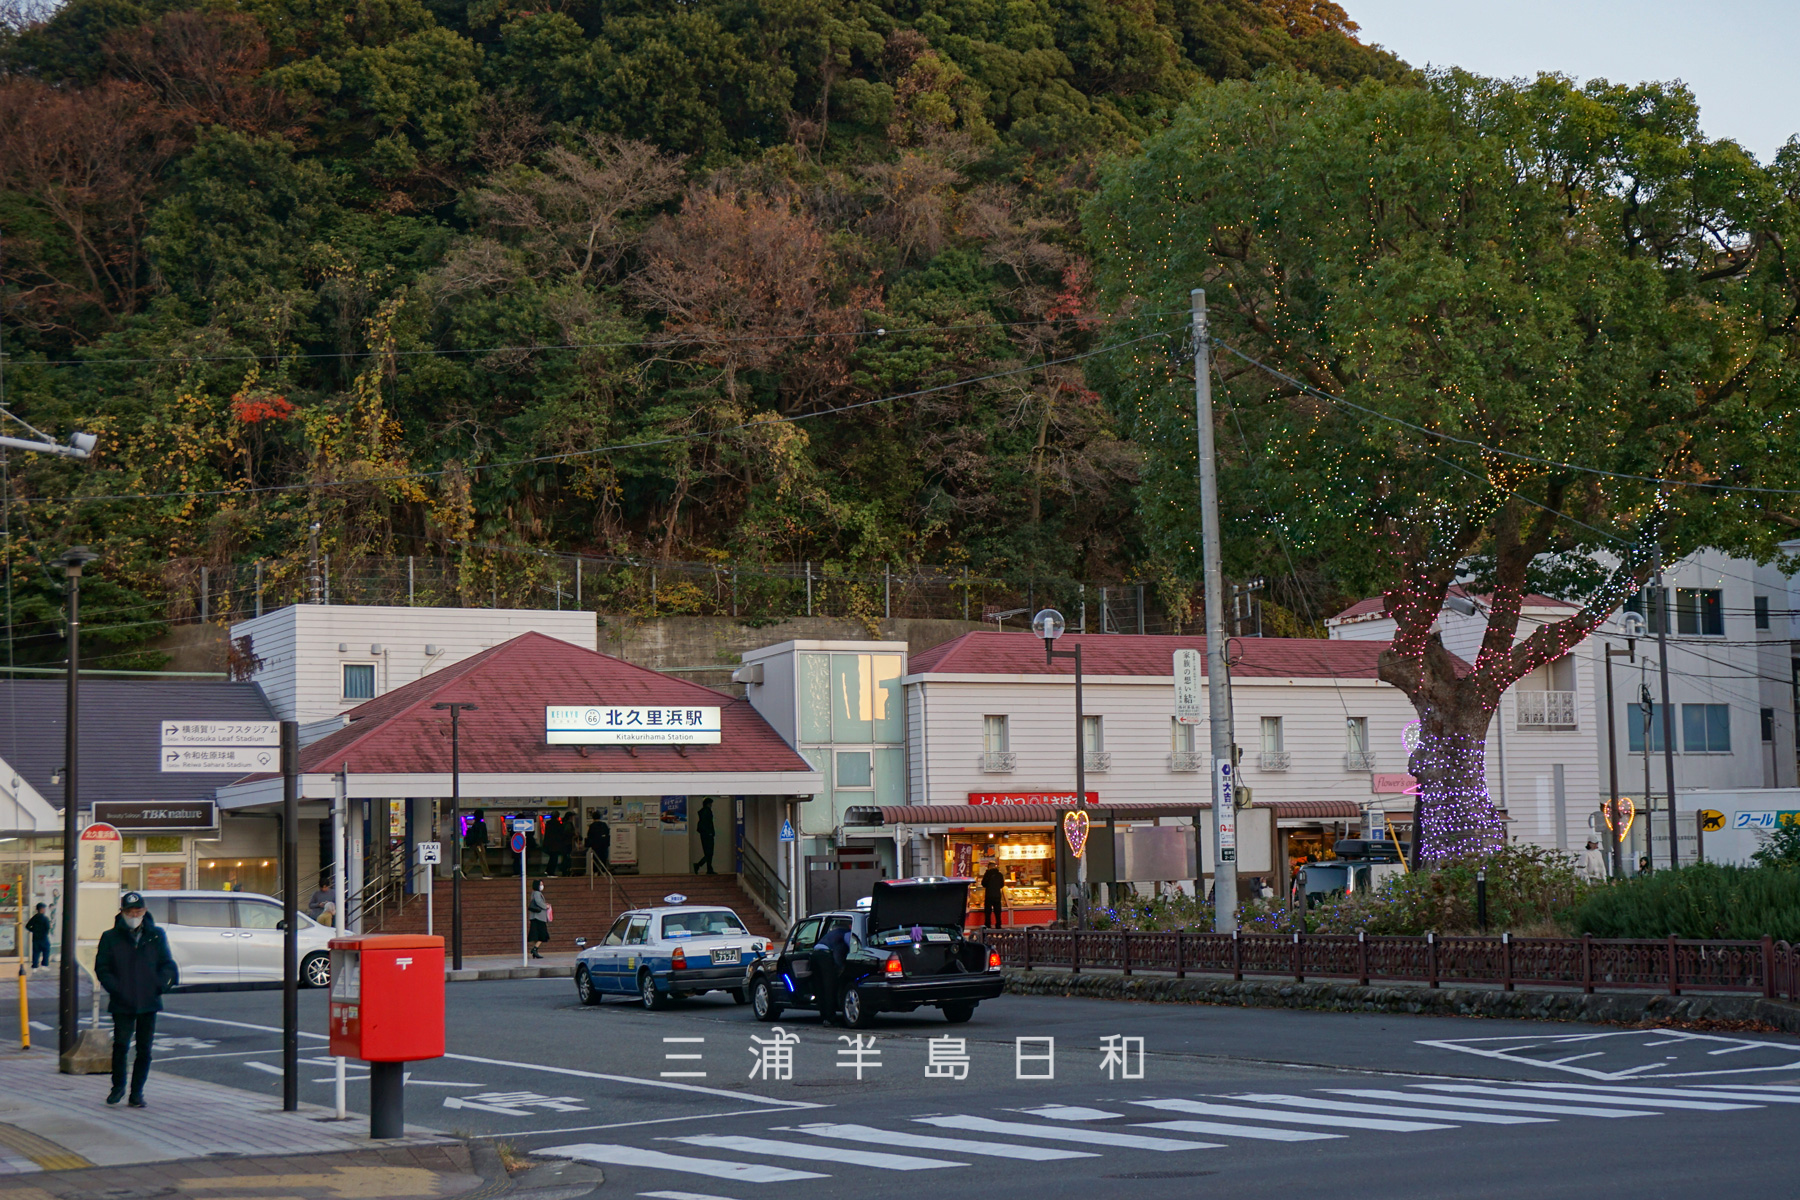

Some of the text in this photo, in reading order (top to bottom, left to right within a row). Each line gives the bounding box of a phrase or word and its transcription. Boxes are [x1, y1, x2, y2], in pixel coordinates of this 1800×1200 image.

[605, 709, 703, 726] 北久里浜駅
[182, 725, 278, 734] 横須賀リーフスタジアム
[616, 733, 694, 741] Kitakurihama Station
[183, 751, 236, 760] 令和佐原球場
[1222, 782, 1232, 803] 大吉
[142, 809, 168, 819] TBK
[168, 808, 203, 819] nature
